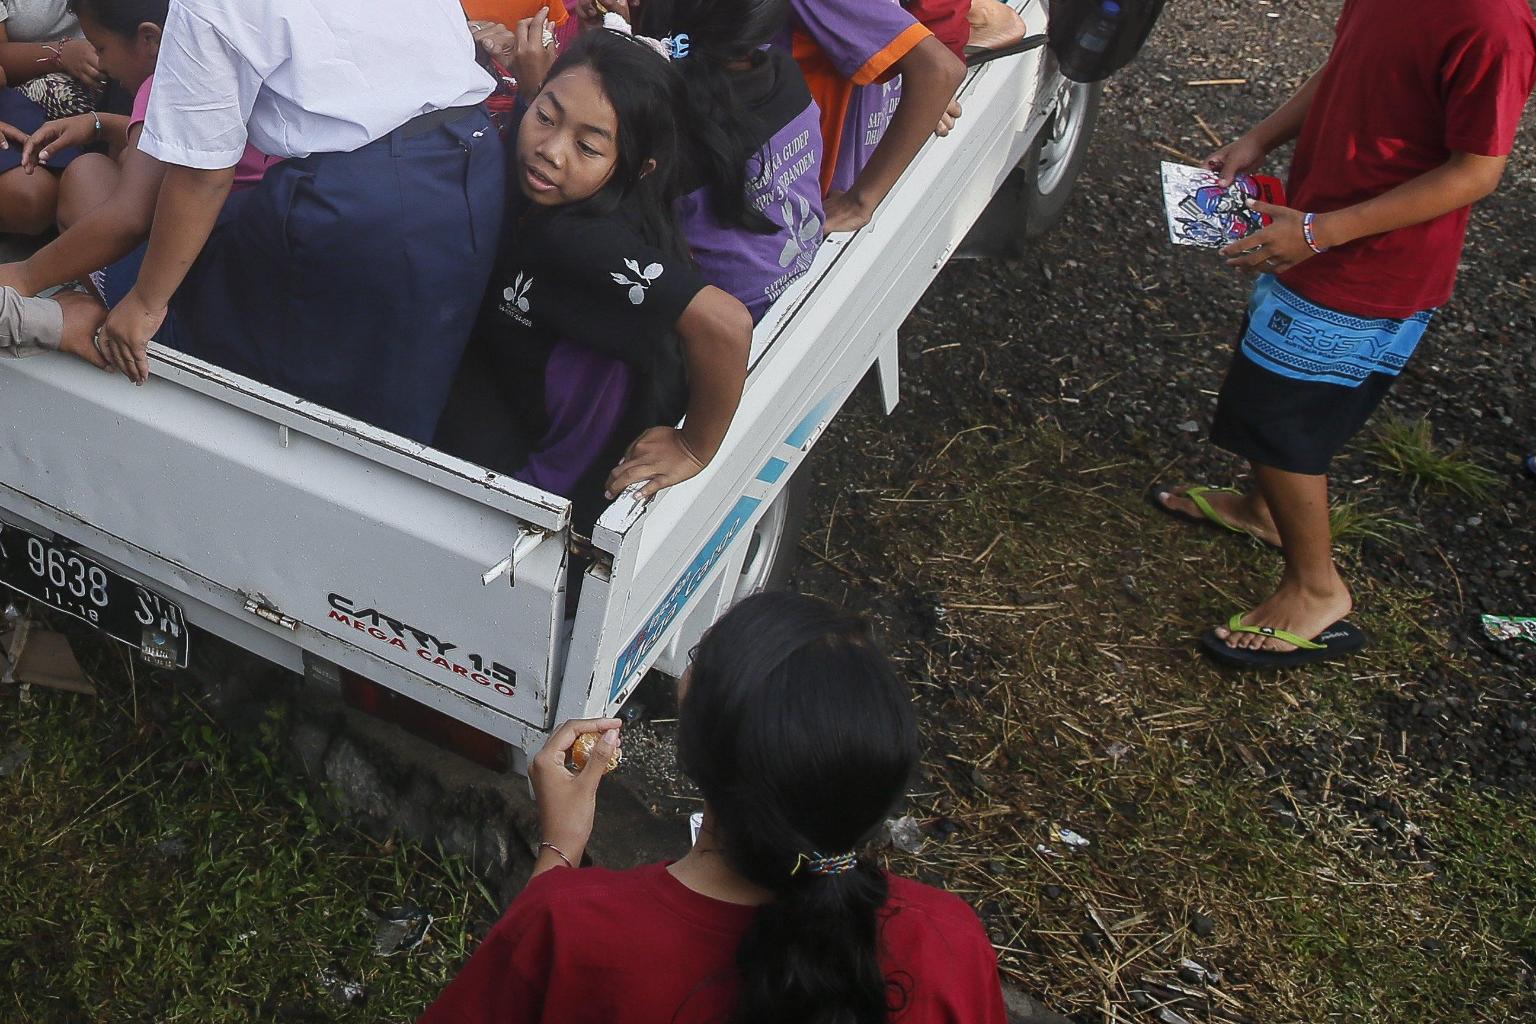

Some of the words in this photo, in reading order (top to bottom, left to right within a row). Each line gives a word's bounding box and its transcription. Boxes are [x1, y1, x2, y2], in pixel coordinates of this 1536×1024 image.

[783, 129, 809, 161] GUDEP
[27, 537, 109, 607] 9638
[327, 592, 458, 656] CARRY
[468, 653, 517, 688] 1.5
[328, 609, 409, 652] MEGA
[416, 648, 515, 697] CARGO
